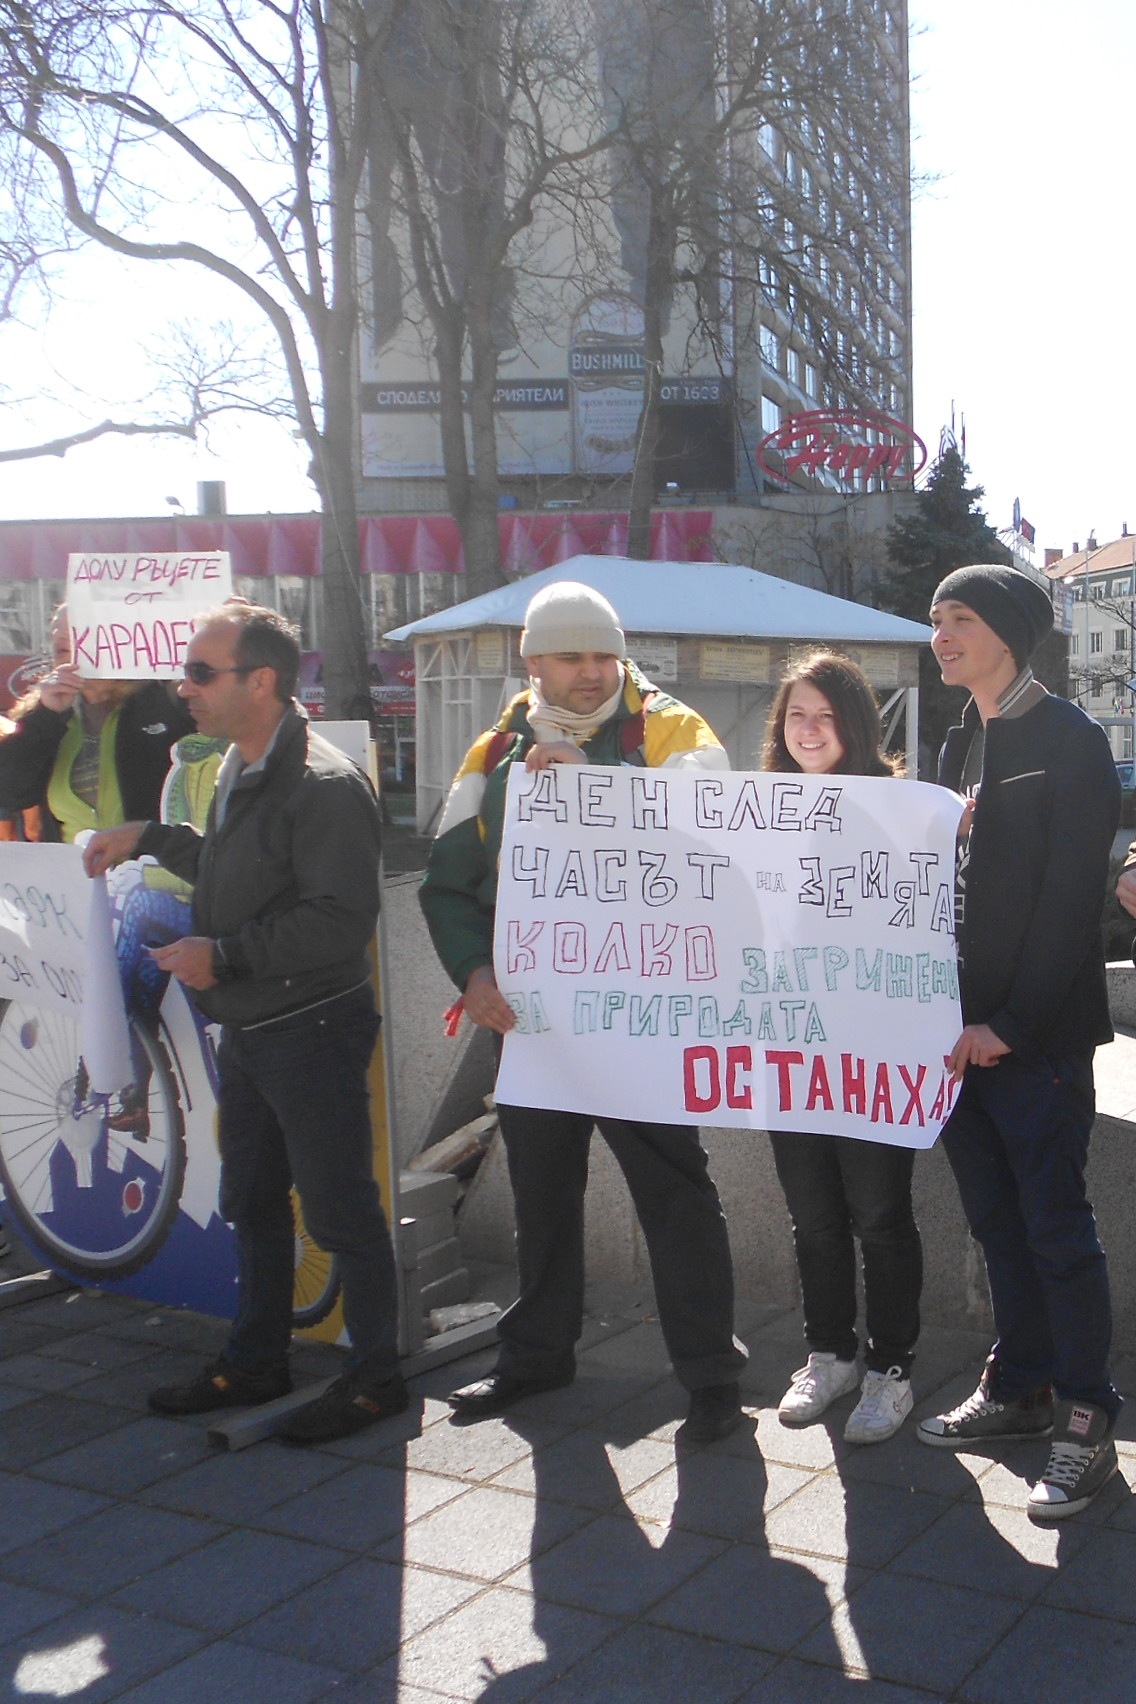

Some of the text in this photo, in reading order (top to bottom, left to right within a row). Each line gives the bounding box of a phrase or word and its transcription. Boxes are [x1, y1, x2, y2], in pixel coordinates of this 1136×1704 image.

[572, 353, 645, 371] BUSHMILL
[493, 387, 564, 403] РИЯТЕЛИ
[777, 426, 910, 482] Happy
[74, 557, 222, 587] ДОЛУ РЪЦЕТЕ
[72, 620, 196, 673] КАРАДЕ
[517, 768, 843, 834] ДЕН СЛЕД
[511, 845, 731, 907] ЧАСЪТ
[798, 850, 956, 935] ЗЕМЯТА
[506, 921, 959, 1004] КОЛКО ЗАГРИЖЕНИ
[511, 990, 827, 1043] ЗА ПРИРОДАТА
